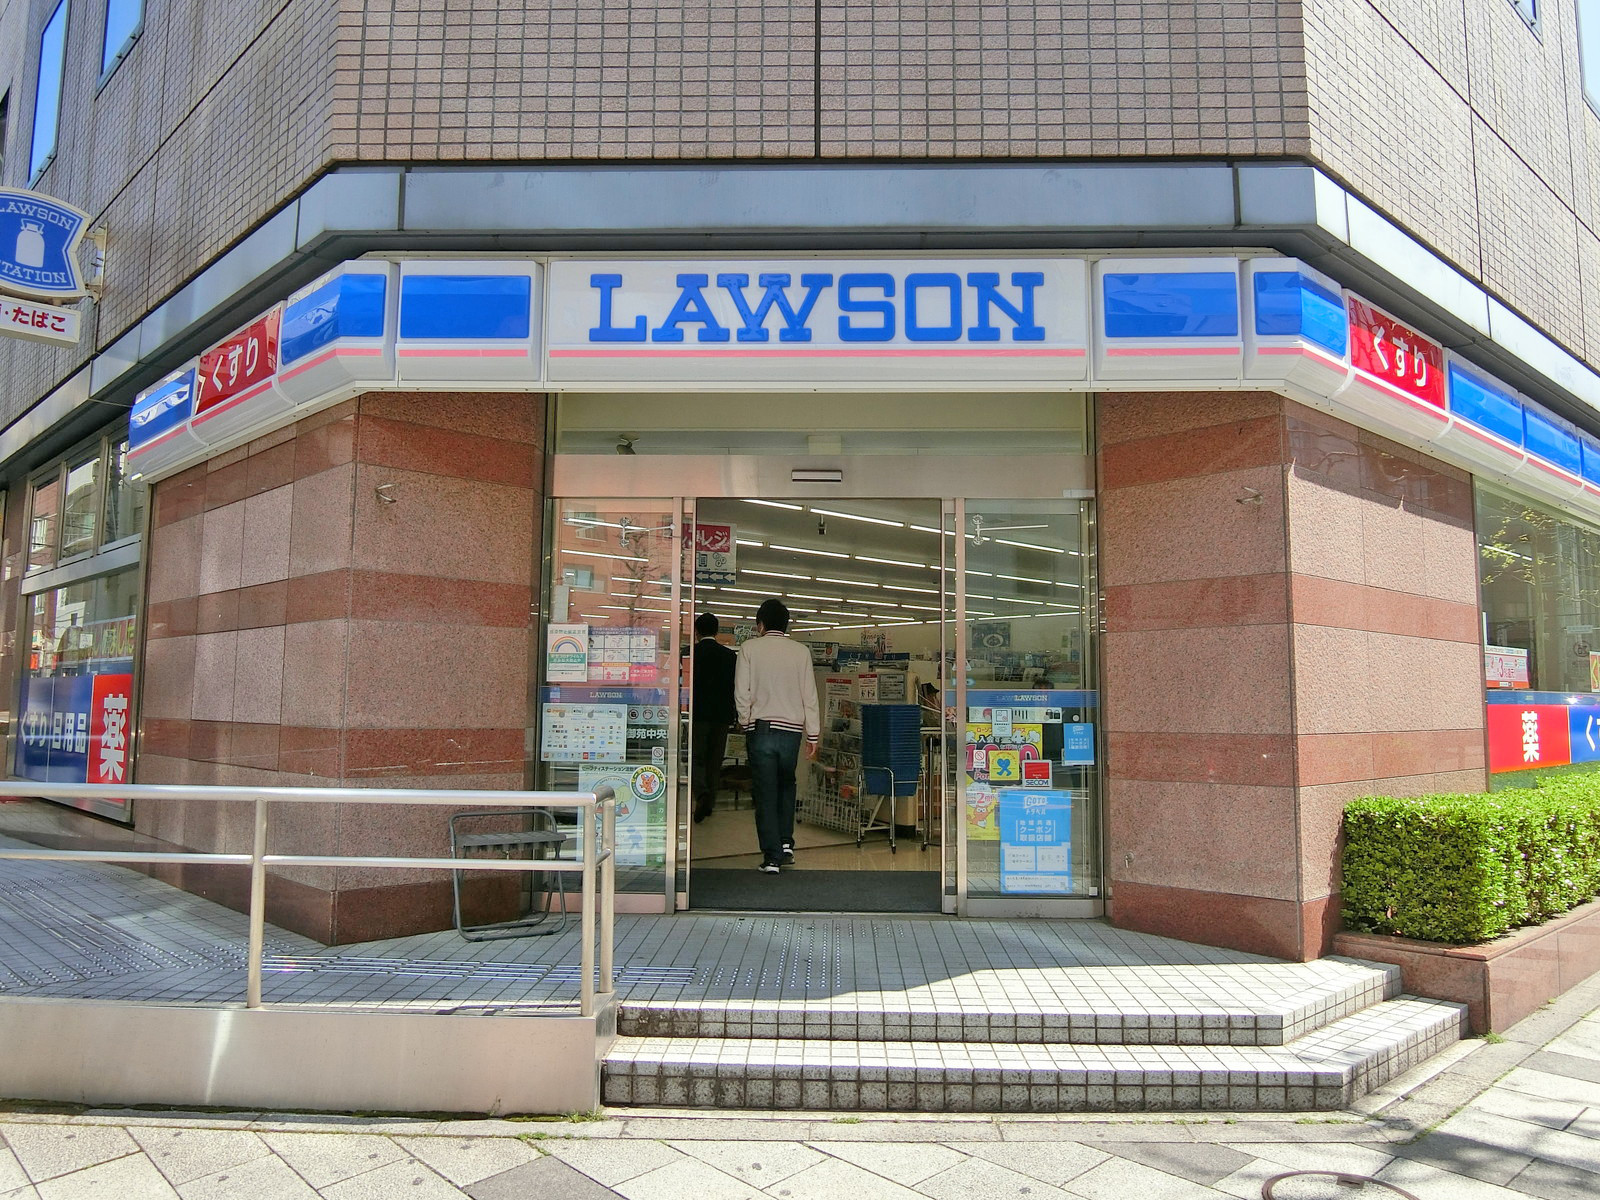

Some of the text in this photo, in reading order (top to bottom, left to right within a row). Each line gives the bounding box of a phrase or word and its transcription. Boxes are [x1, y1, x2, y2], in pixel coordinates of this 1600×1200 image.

[0, 261, 67, 283] TATION
[0, 304, 66, 333] ・たばこ
[589, 272, 1046, 342] LAWSON
[212, 336, 259, 392] くすり
[1373, 326, 1428, 387] くすり
[1014, 694, 1048, 702] LAWSON
[20, 711, 87, 753] くすり 日用品
[99, 693, 128, 782] 薬
[626, 727, 669, 740] 御苑中央
[1521, 710, 1540, 763] 薬
[1585, 714, 1600, 752] く
[1020, 826, 1052, 834] クーポン
